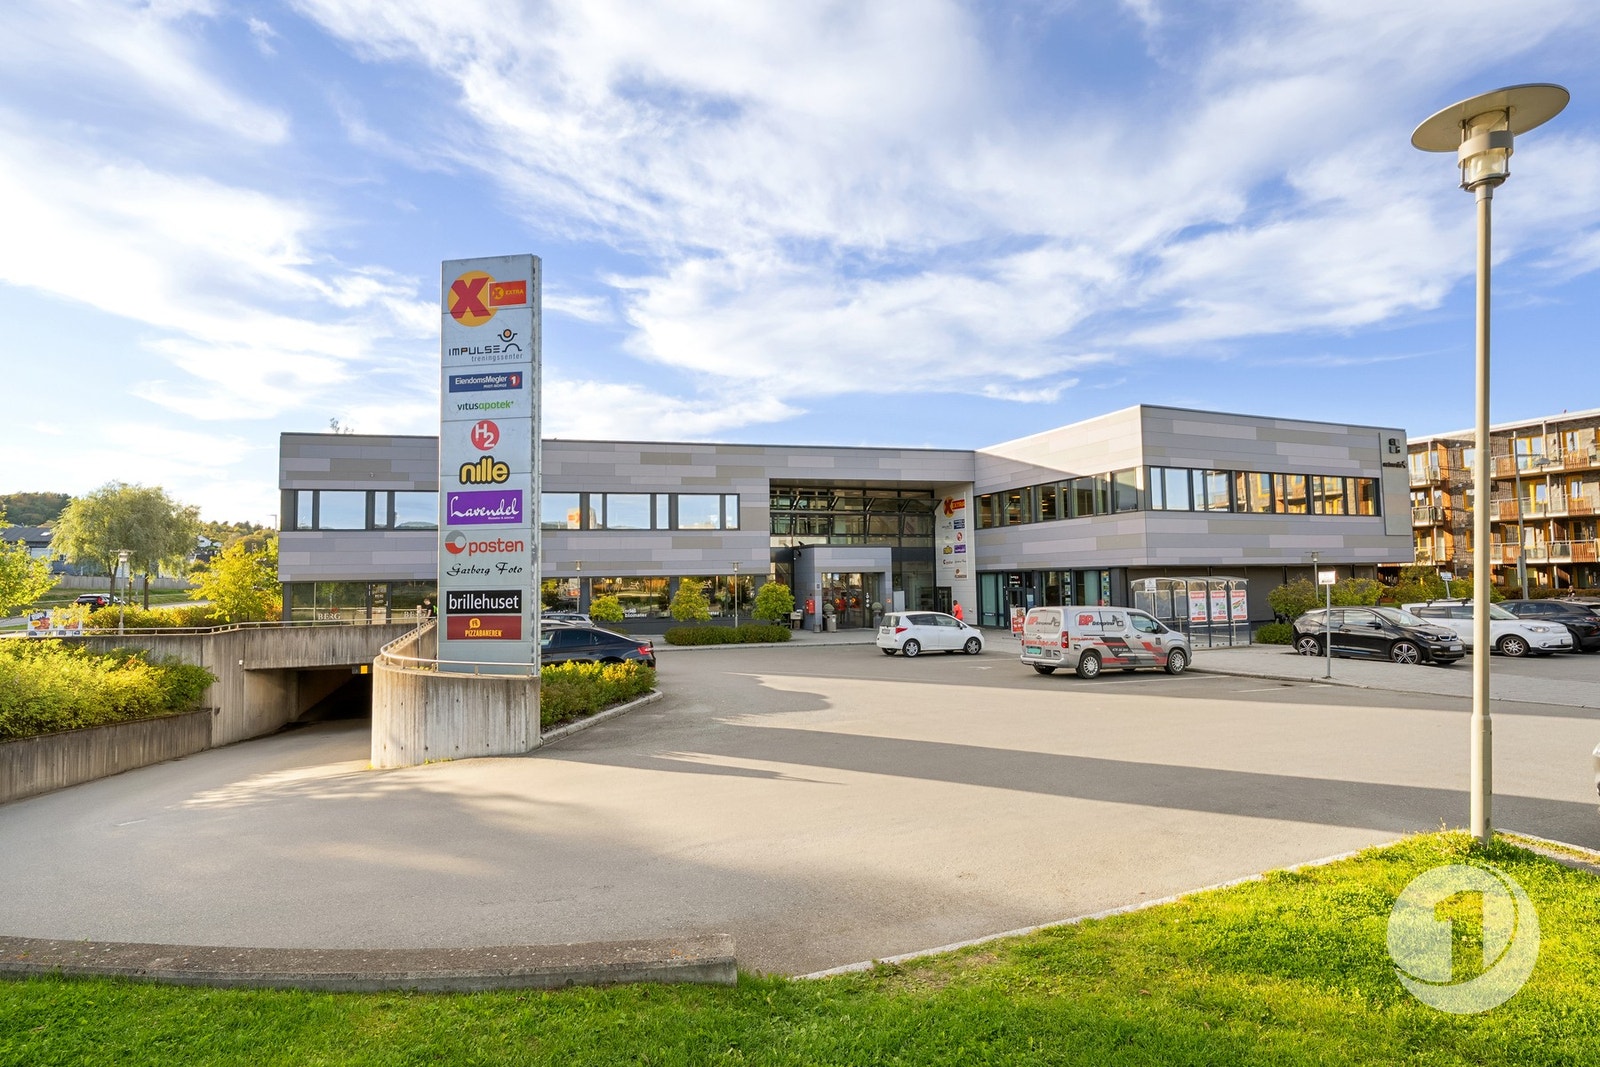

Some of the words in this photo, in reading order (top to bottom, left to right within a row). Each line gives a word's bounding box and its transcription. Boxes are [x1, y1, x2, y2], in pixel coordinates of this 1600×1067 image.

[448, 345, 500, 356] IMPULSE
[471, 353, 523, 362] treningssenter
[455, 375, 507, 385] EiendomsMegler
[475, 423, 495, 447] H2
[460, 457, 509, 483] nille
[450, 495, 520, 517] Lavendel
[469, 538, 524, 556] posten
[446, 563, 491, 576] Garberg
[495, 562, 523, 575] Foto
[448, 593, 519, 609] brillehuset
[318, 612, 341, 620] BERG
